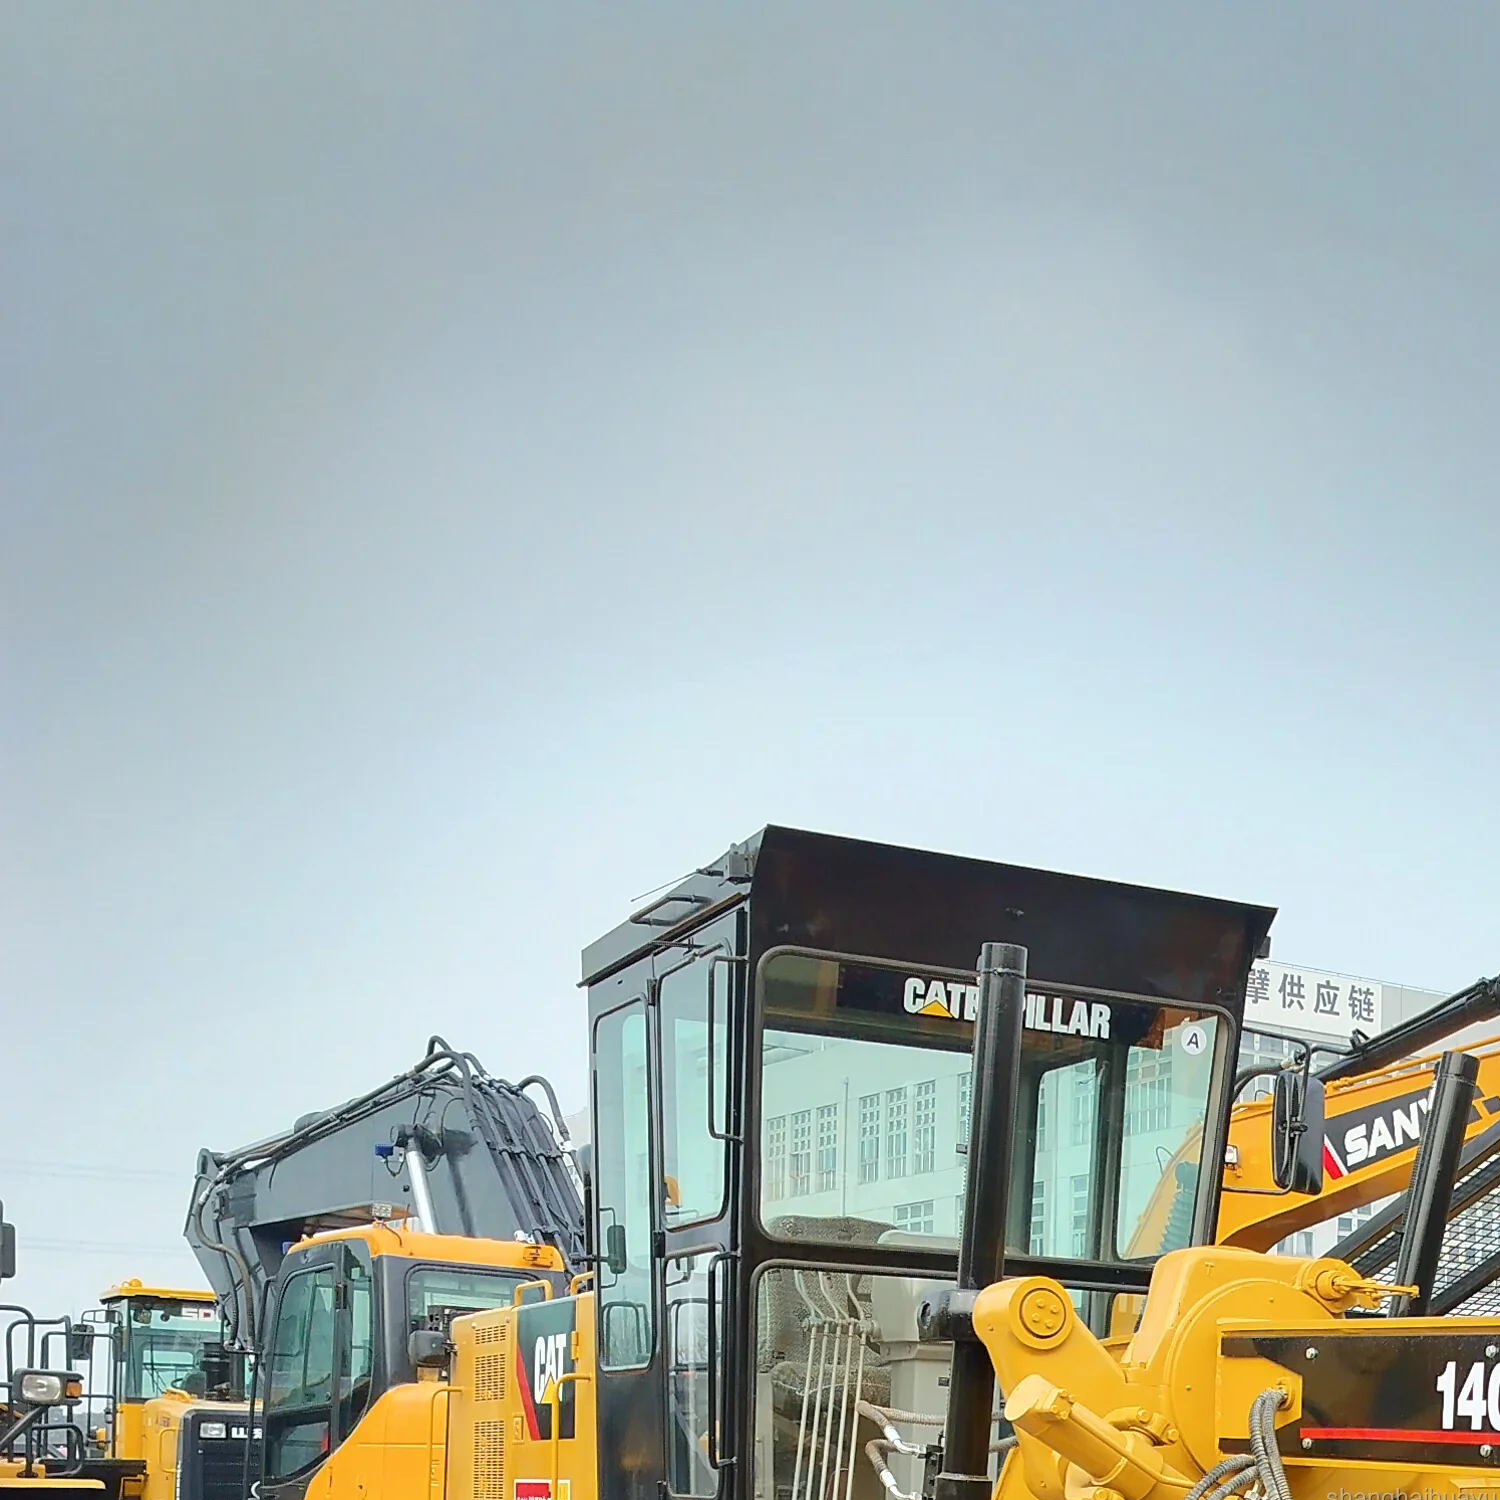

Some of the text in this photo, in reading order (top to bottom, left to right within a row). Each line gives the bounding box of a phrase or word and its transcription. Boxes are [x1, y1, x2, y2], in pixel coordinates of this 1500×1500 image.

[903, 977, 1112, 1040] CATEILLAR
[1187, 1032, 1200, 1049] A
[534, 1333, 567, 1404] CAT
